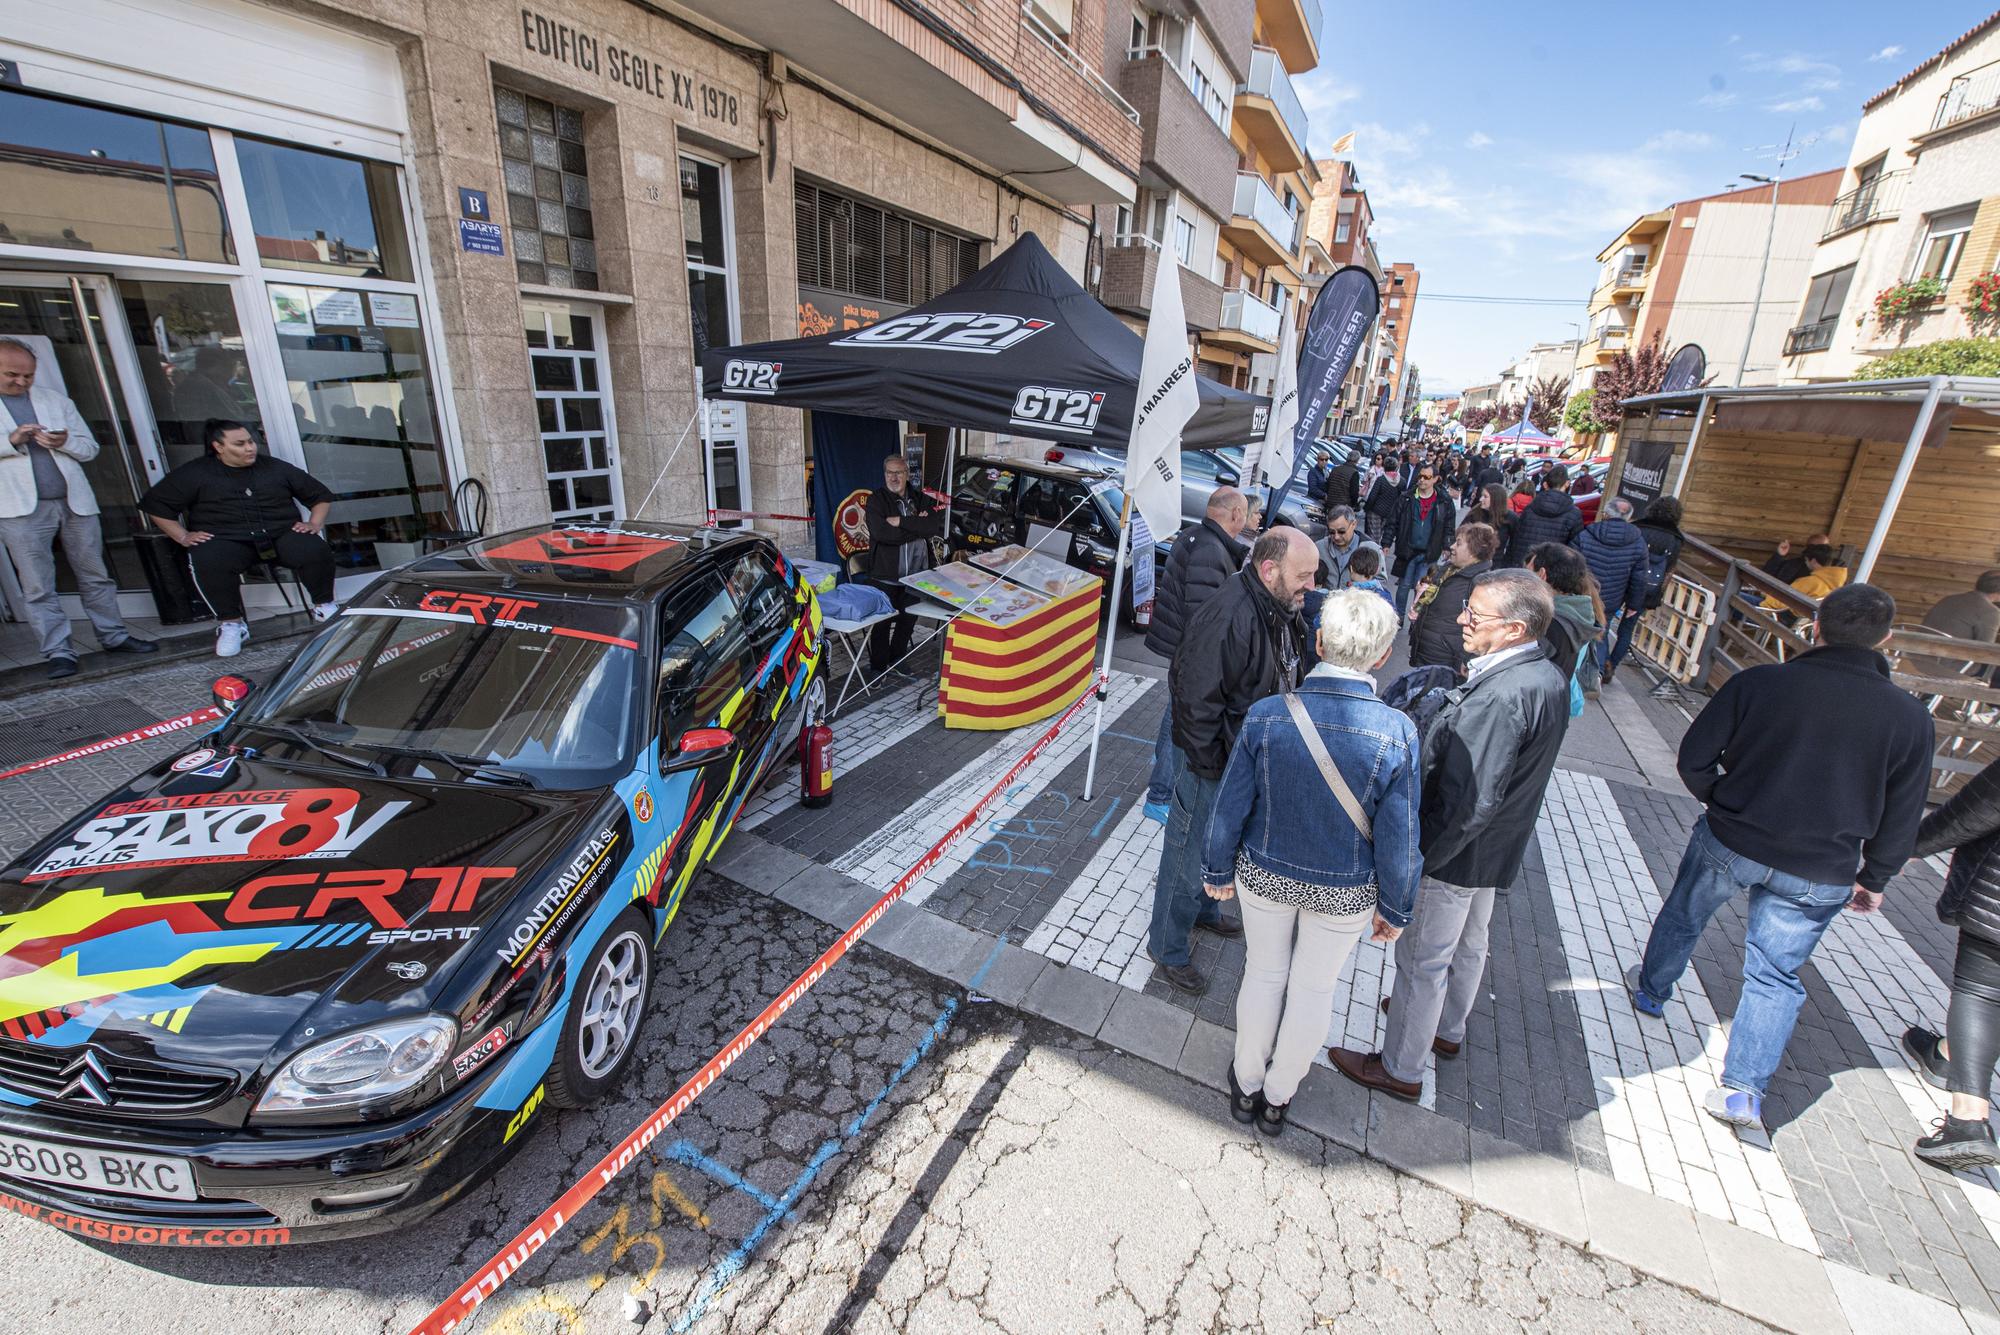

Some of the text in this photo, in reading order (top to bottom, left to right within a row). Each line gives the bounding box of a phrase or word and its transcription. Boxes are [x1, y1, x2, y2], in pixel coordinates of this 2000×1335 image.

[522, 9, 738, 126] EDIFICI SEGLE XX 1978
[842, 313, 1054, 349] GT2i
[723, 359, 782, 391] GT2i
[1142, 357, 1193, 415] MANRESA
[1297, 310, 1363, 441] CARS MANRESA
[1012, 386, 1106, 429] GT2i
[492, 619, 552, 633] SPORT
[103, 791, 298, 816] CHALLENGE
[495, 837, 608, 964] MONTRAVETA
[598, 825, 616, 843] SL
[532, 855, 617, 951] www.montravetasl.com
[366, 926, 480, 945] SPORT
[99, 1156, 180, 1192] BKC
